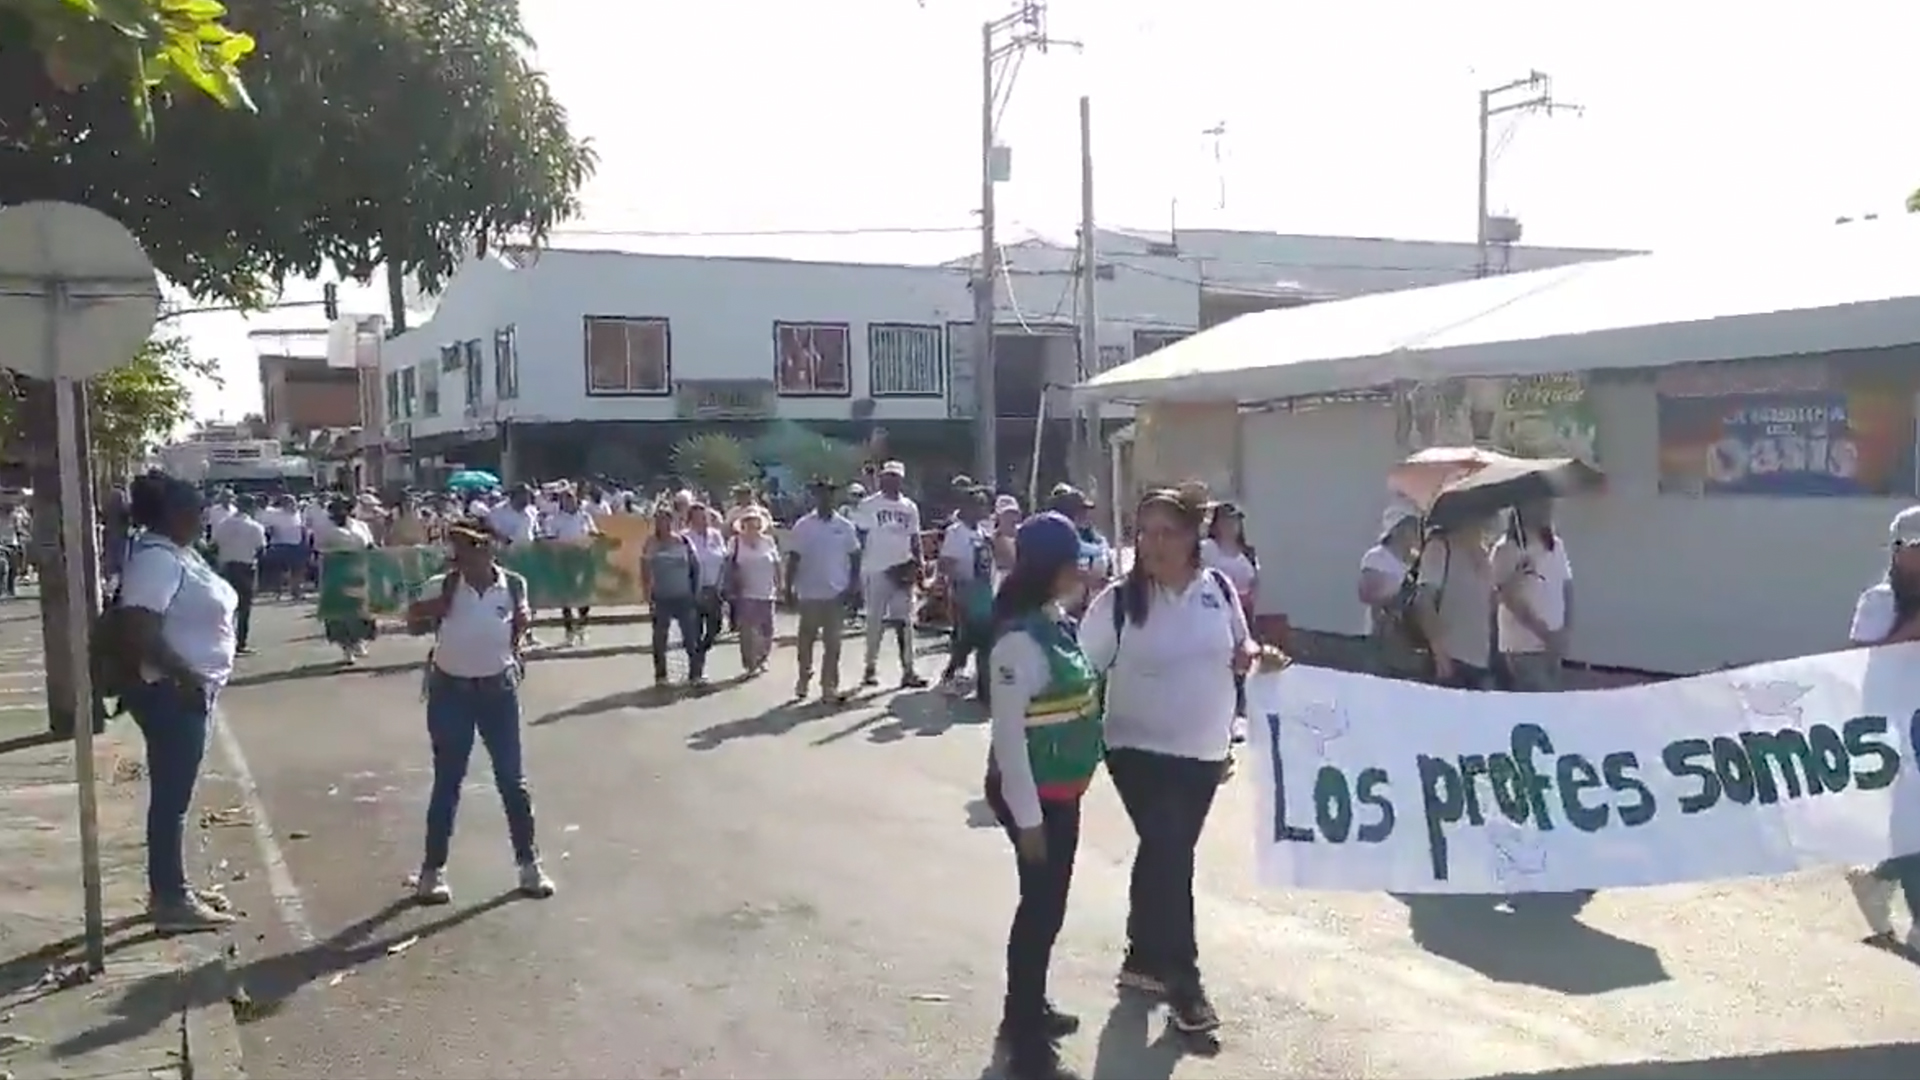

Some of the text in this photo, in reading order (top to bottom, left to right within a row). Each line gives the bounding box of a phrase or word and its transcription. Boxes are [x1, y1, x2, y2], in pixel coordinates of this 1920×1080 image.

[1266, 713, 1395, 844] Los
[1416, 722, 1657, 881] profes
[1662, 715, 1903, 815] somos
